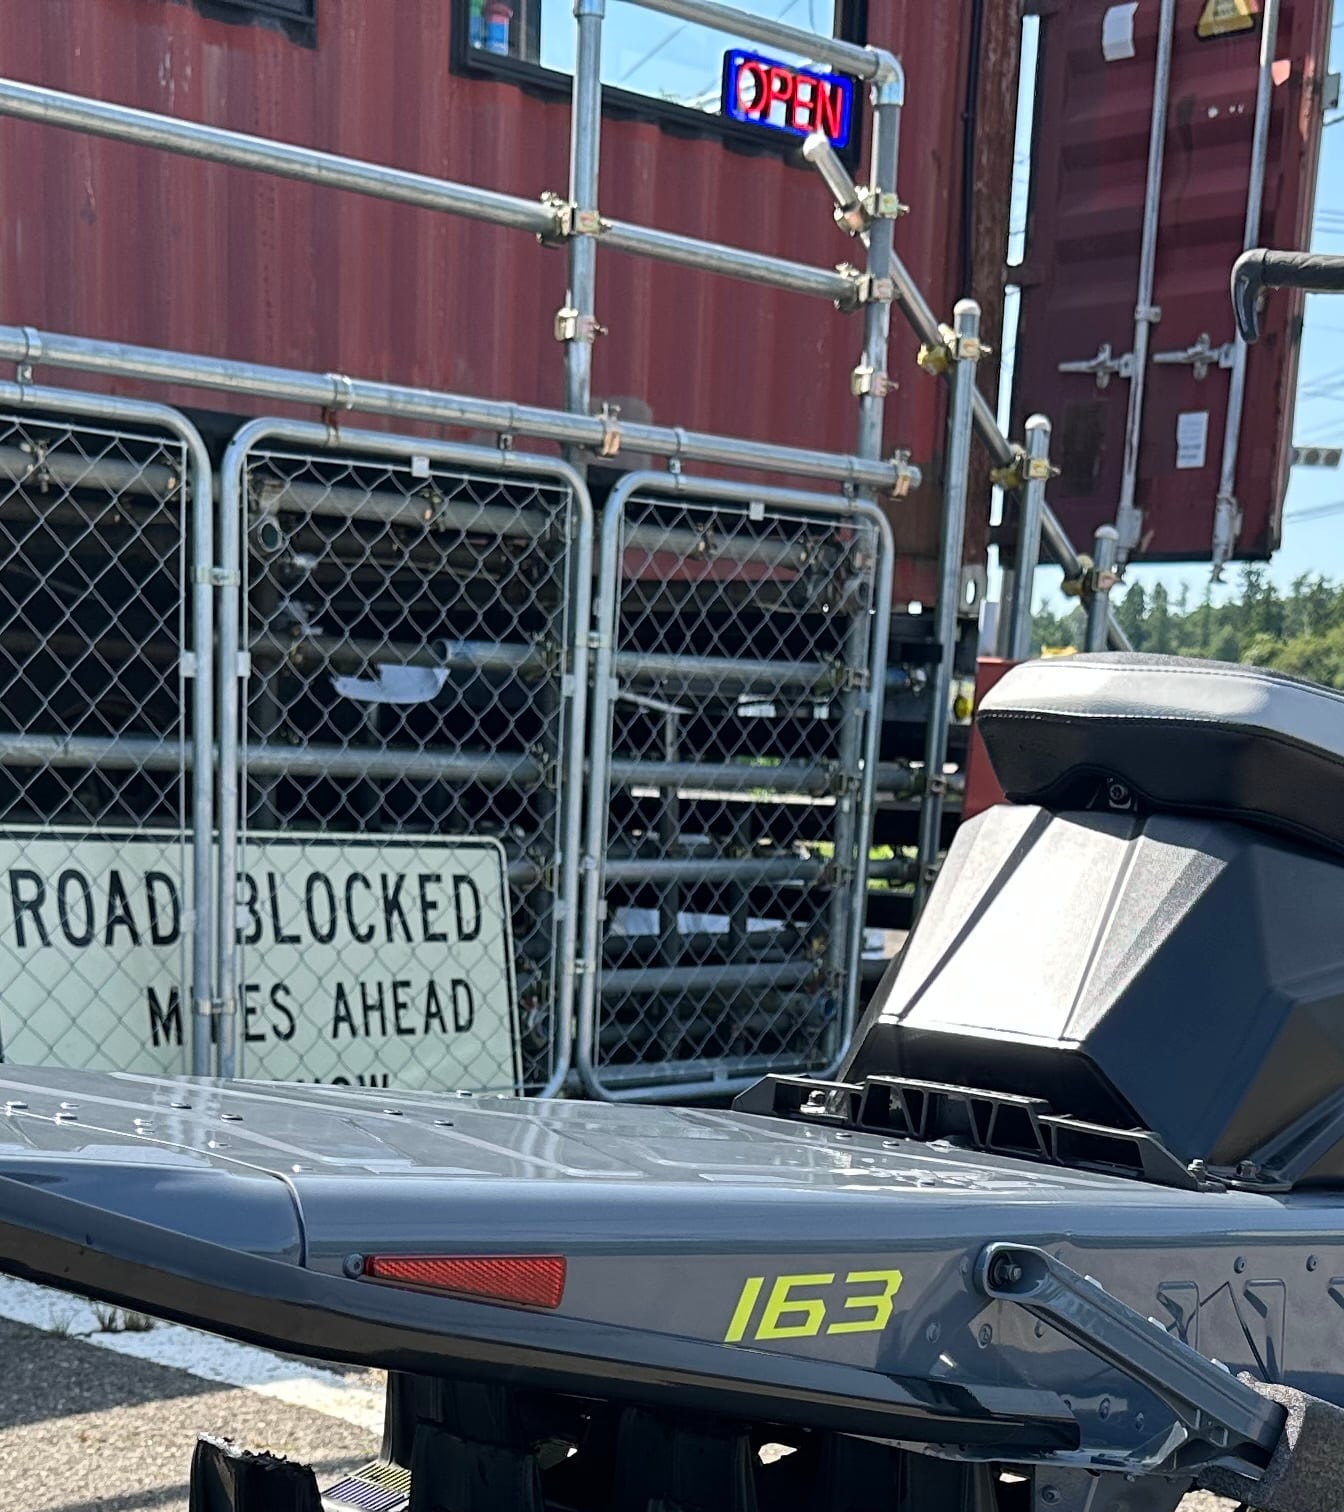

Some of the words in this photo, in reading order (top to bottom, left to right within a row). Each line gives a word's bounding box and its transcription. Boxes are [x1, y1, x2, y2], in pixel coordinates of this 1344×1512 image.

[737, 61, 843, 139] OPEN
[9, 868, 182, 948] ROAD
[236, 870, 482, 945] BLOCKED
[148, 980, 296, 1047] MES
[332, 977, 475, 1039] AHEAD
[724, 1269, 903, 1343] 163
